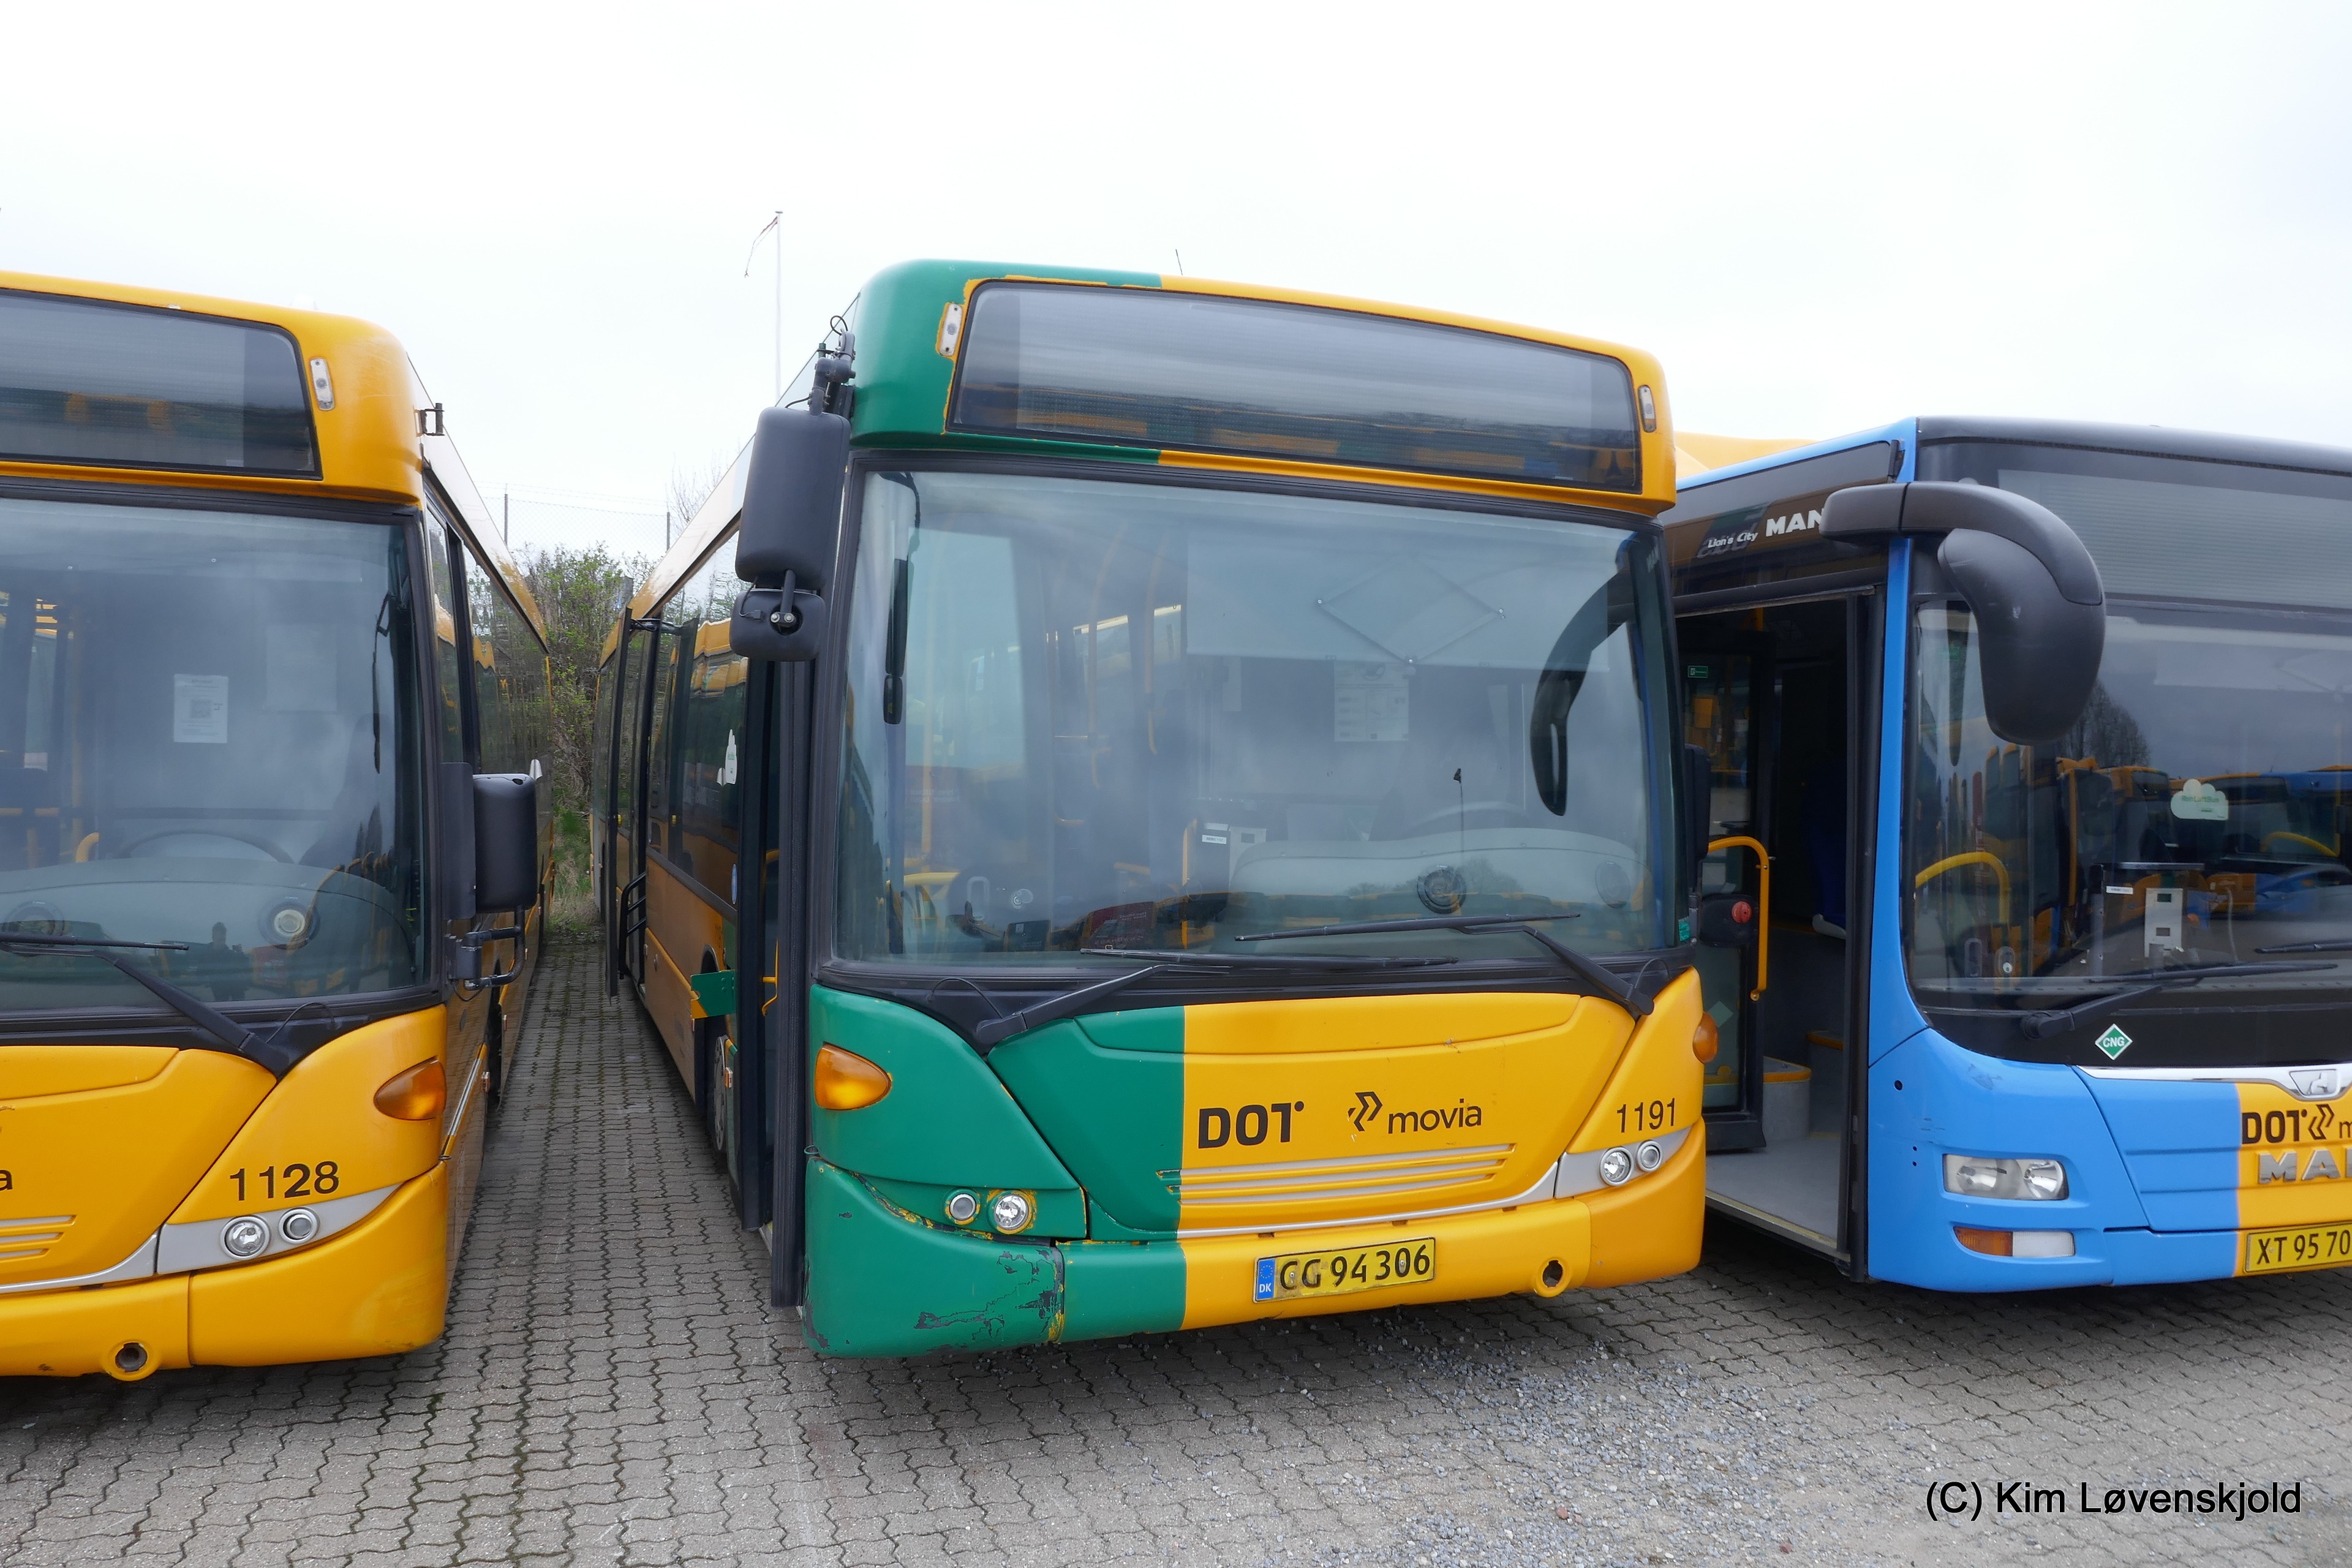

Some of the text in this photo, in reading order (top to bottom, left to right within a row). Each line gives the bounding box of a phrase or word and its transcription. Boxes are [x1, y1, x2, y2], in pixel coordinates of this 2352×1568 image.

[1708, 536, 1733, 548] Lion's
[1736, 532, 1759, 542] City
[2103, 1036, 2125, 1047] CNG
[1197, 1098, 1482, 1149] DOT movia
[1615, 1098, 1676, 1134] 1191
[2242, 1109, 2307, 1144] DOT
[230, 1160, 341, 1202] 1128
[2259, 1147, 2352, 1185] MA
[2256, 1229, 2351, 1265] XT 95 70
[1280, 1244, 1431, 1291] CG 94 306
[1259, 1282, 1272, 1293] DK
